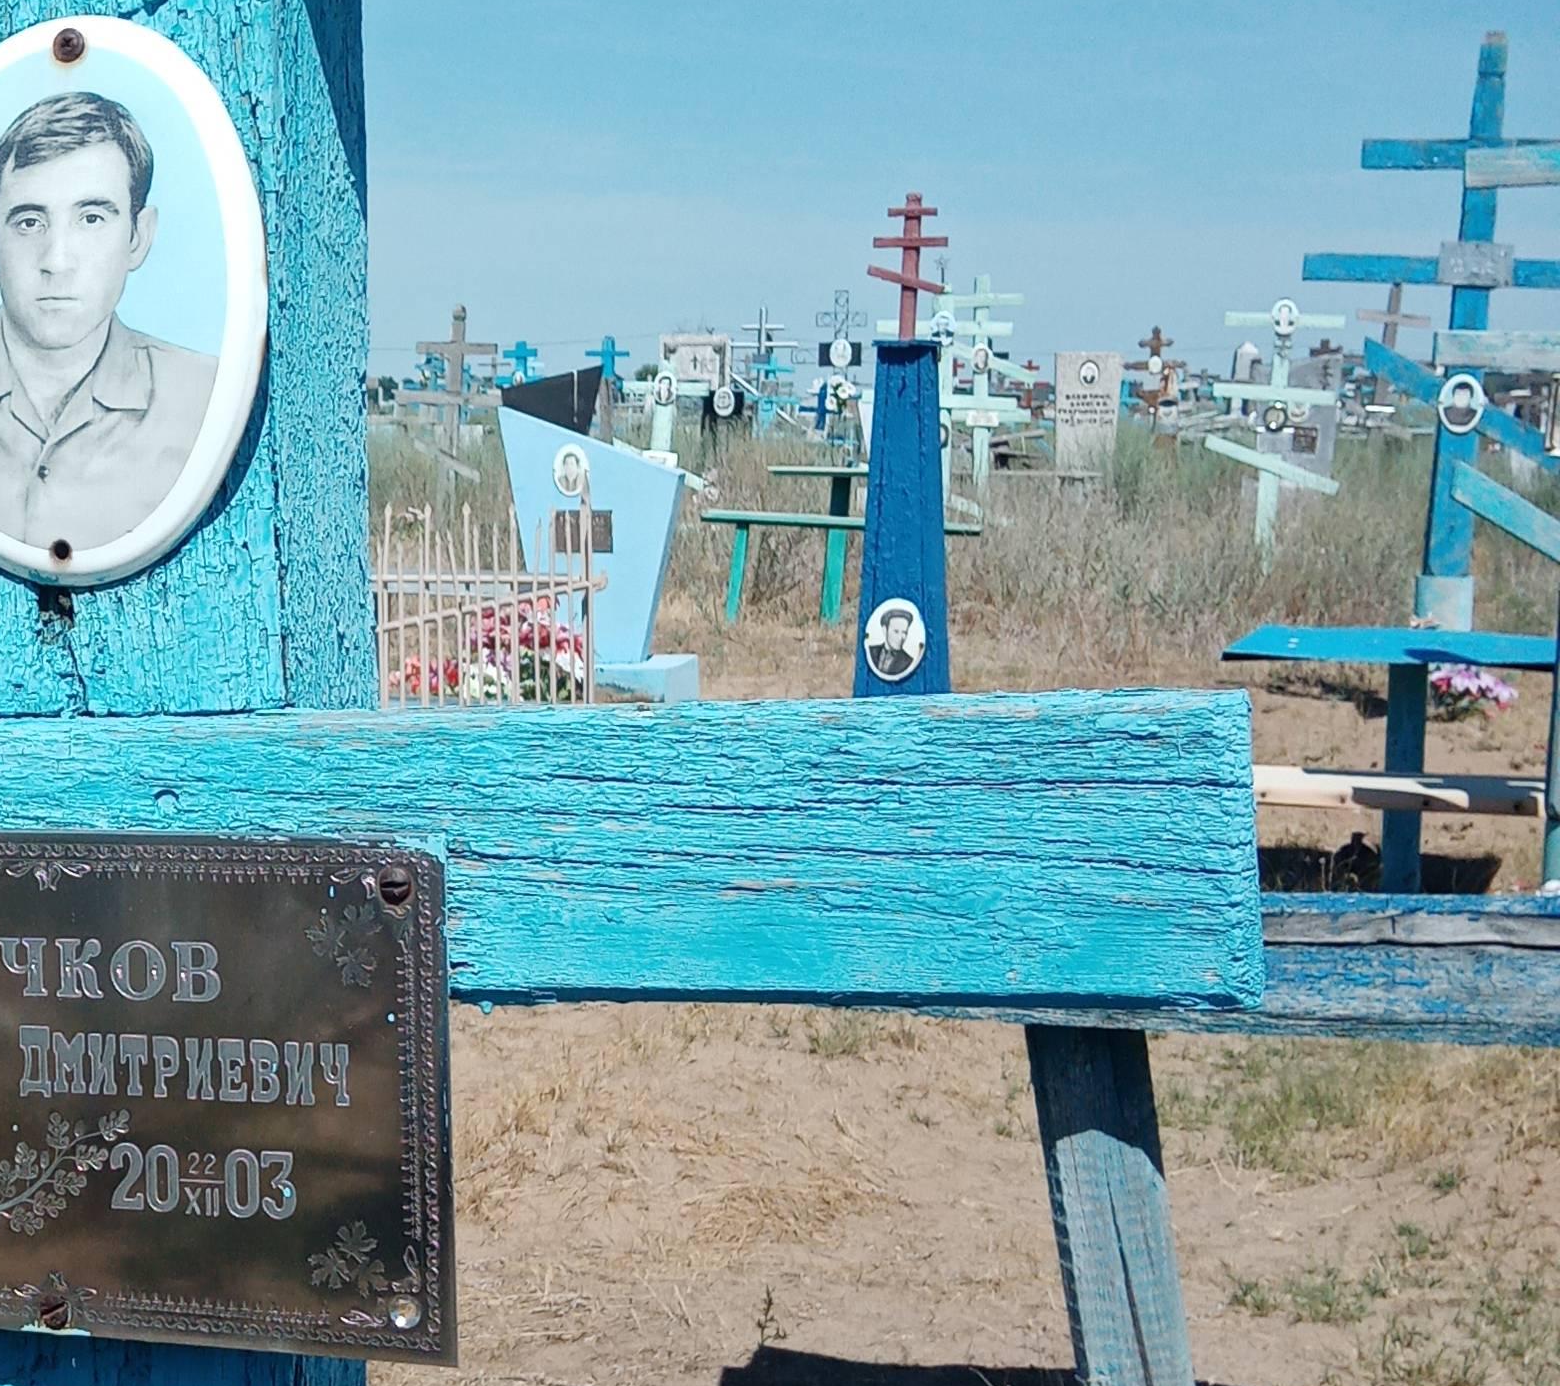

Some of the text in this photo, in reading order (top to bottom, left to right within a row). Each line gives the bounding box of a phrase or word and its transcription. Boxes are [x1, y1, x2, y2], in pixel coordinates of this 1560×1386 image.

[18, 1024, 351, 1107] ДМИТРИЕВИЧ
[109, 1142, 180, 1213] 20
[186, 1151, 217, 1176] 22
[223, 1148, 298, 1221] 03
